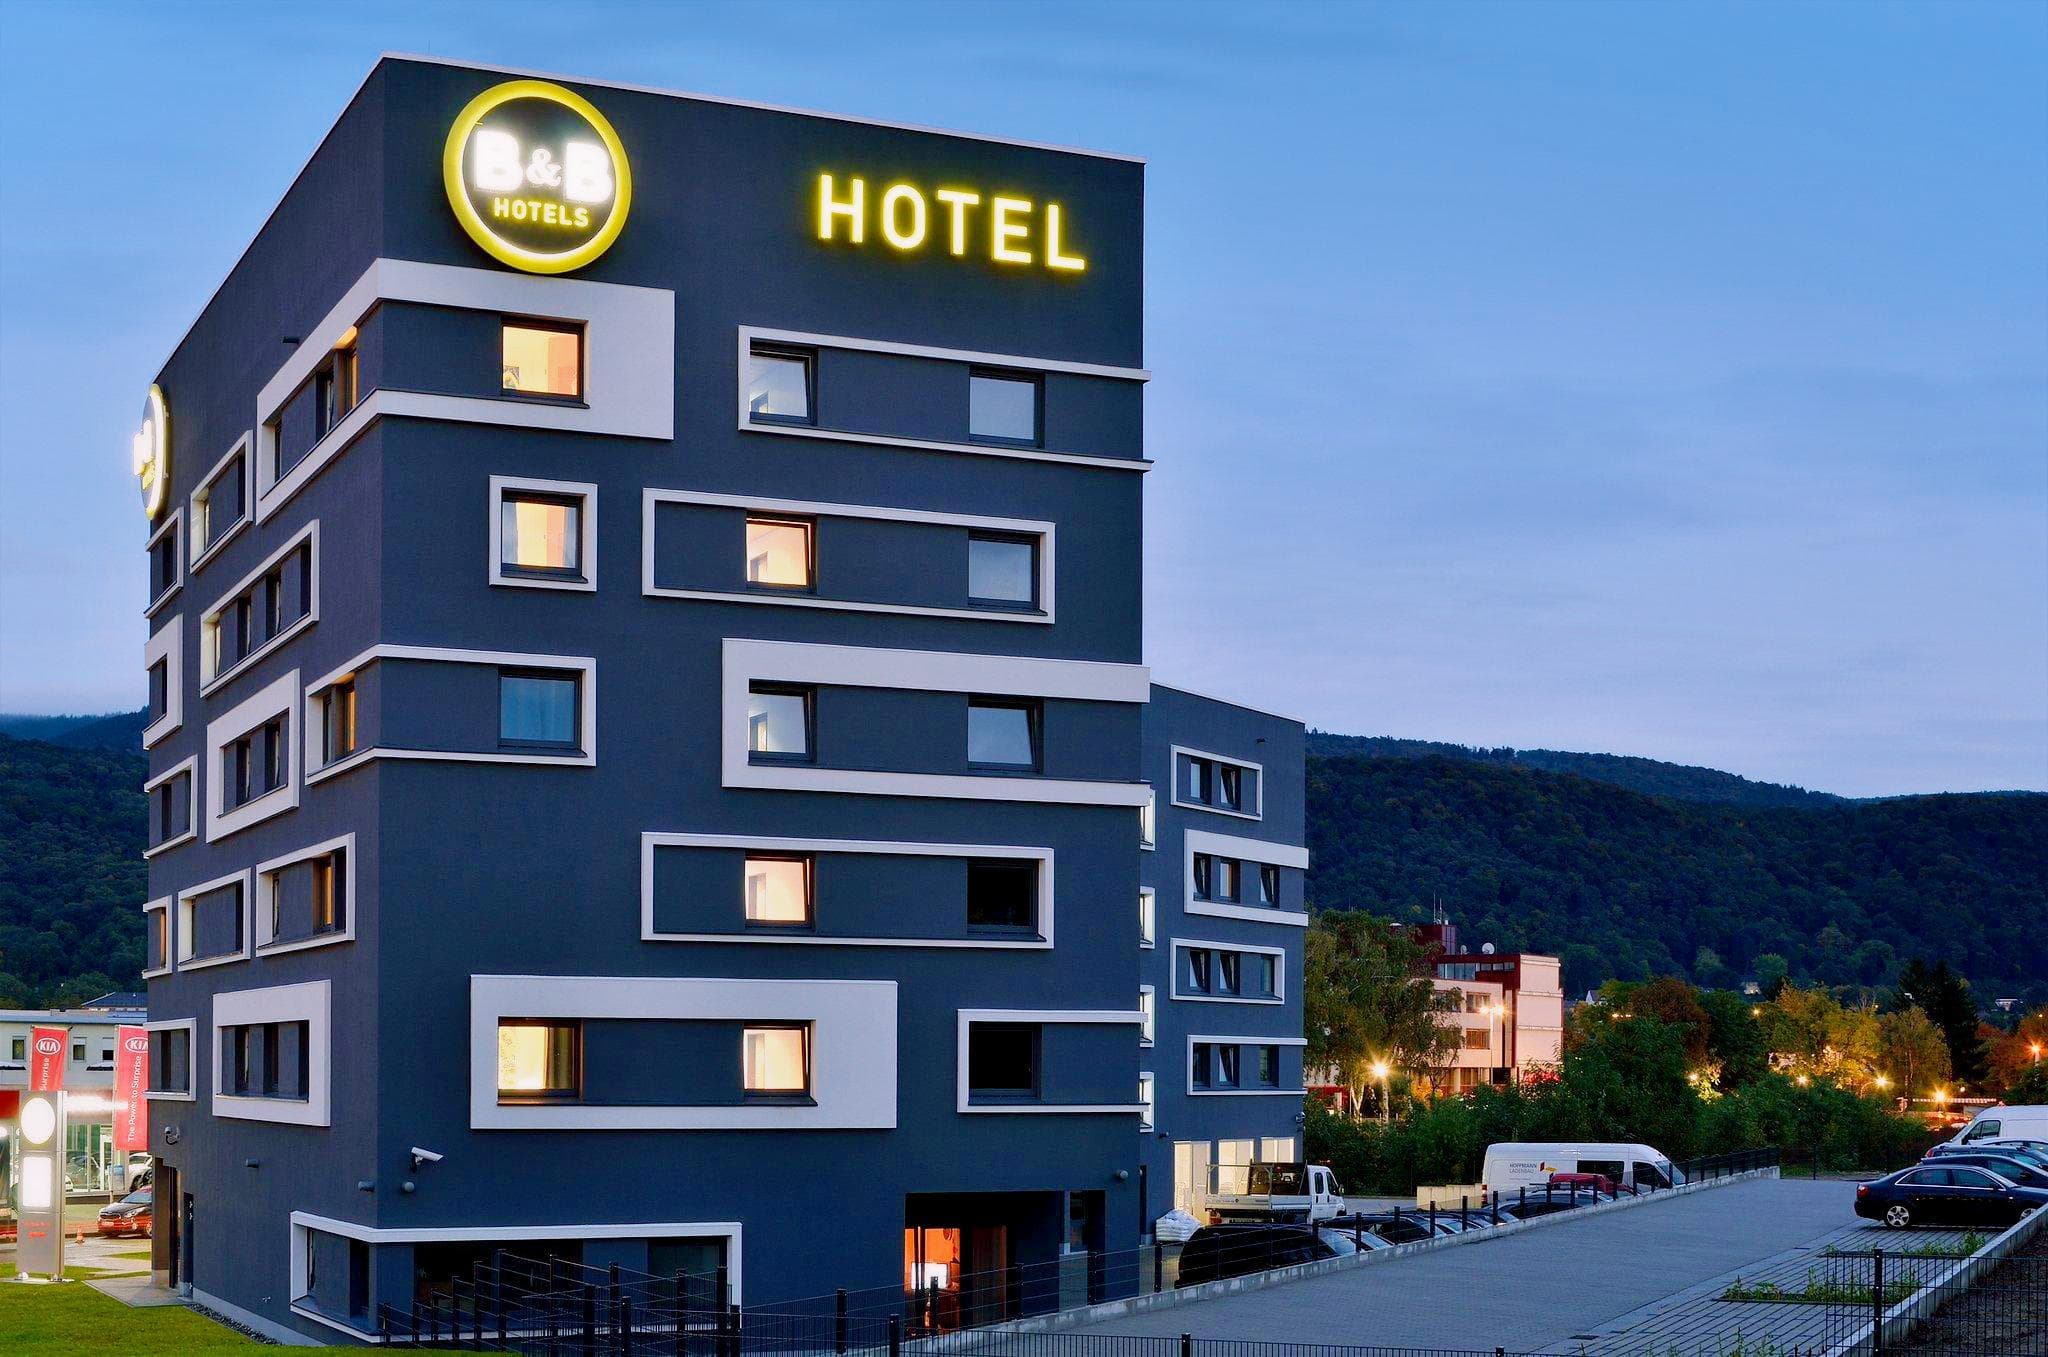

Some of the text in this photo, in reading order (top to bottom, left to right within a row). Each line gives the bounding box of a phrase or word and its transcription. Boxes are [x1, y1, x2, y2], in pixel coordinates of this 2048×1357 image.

[475, 129, 614, 204] B&B
[493, 197, 590, 228] HOTELS
[819, 173, 1086, 271] HOTEL
[40, 1041, 57, 1051] KIA
[131, 1056, 142, 1088] Surprise
[128, 1101, 137, 1125] Power
[127, 1127, 136, 1143] The
